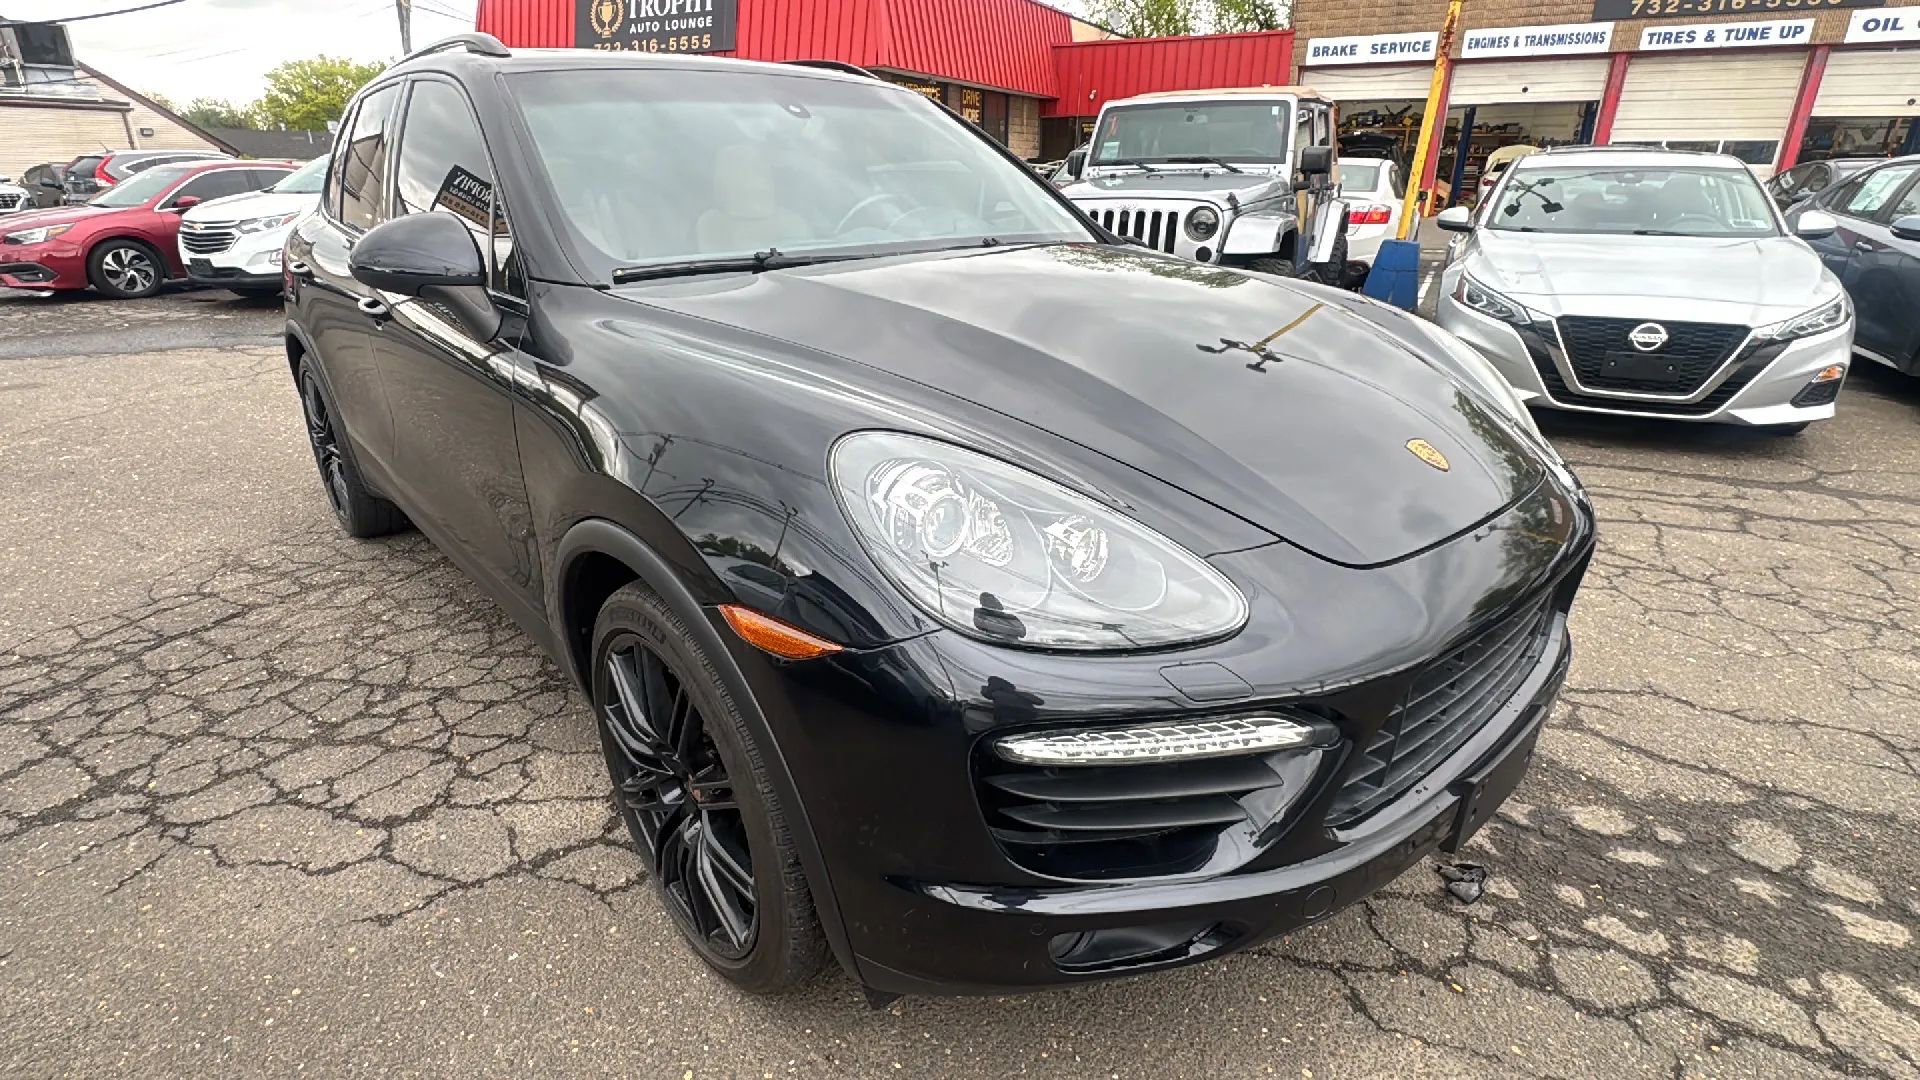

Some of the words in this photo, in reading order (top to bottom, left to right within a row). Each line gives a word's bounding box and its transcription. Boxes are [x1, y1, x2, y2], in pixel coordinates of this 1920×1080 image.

[629, 21, 660, 34] AUTO
[665, 15, 713, 31] LOUNGE
[1862, 17, 1904, 32] OIL
[1467, 36, 1510, 50] ENGINES
[1513, 35, 1520, 48] &
[1524, 31, 1607, 47] TRANSMISSIONS
[1647, 30, 1697, 45] TIRES
[1704, 29, 1716, 42] &
[1725, 26, 1772, 42] TUNE
[1779, 25, 1804, 39] UP
[1312, 44, 1358, 58] BRAKE
[1370, 39, 1432, 54] SERVICE
